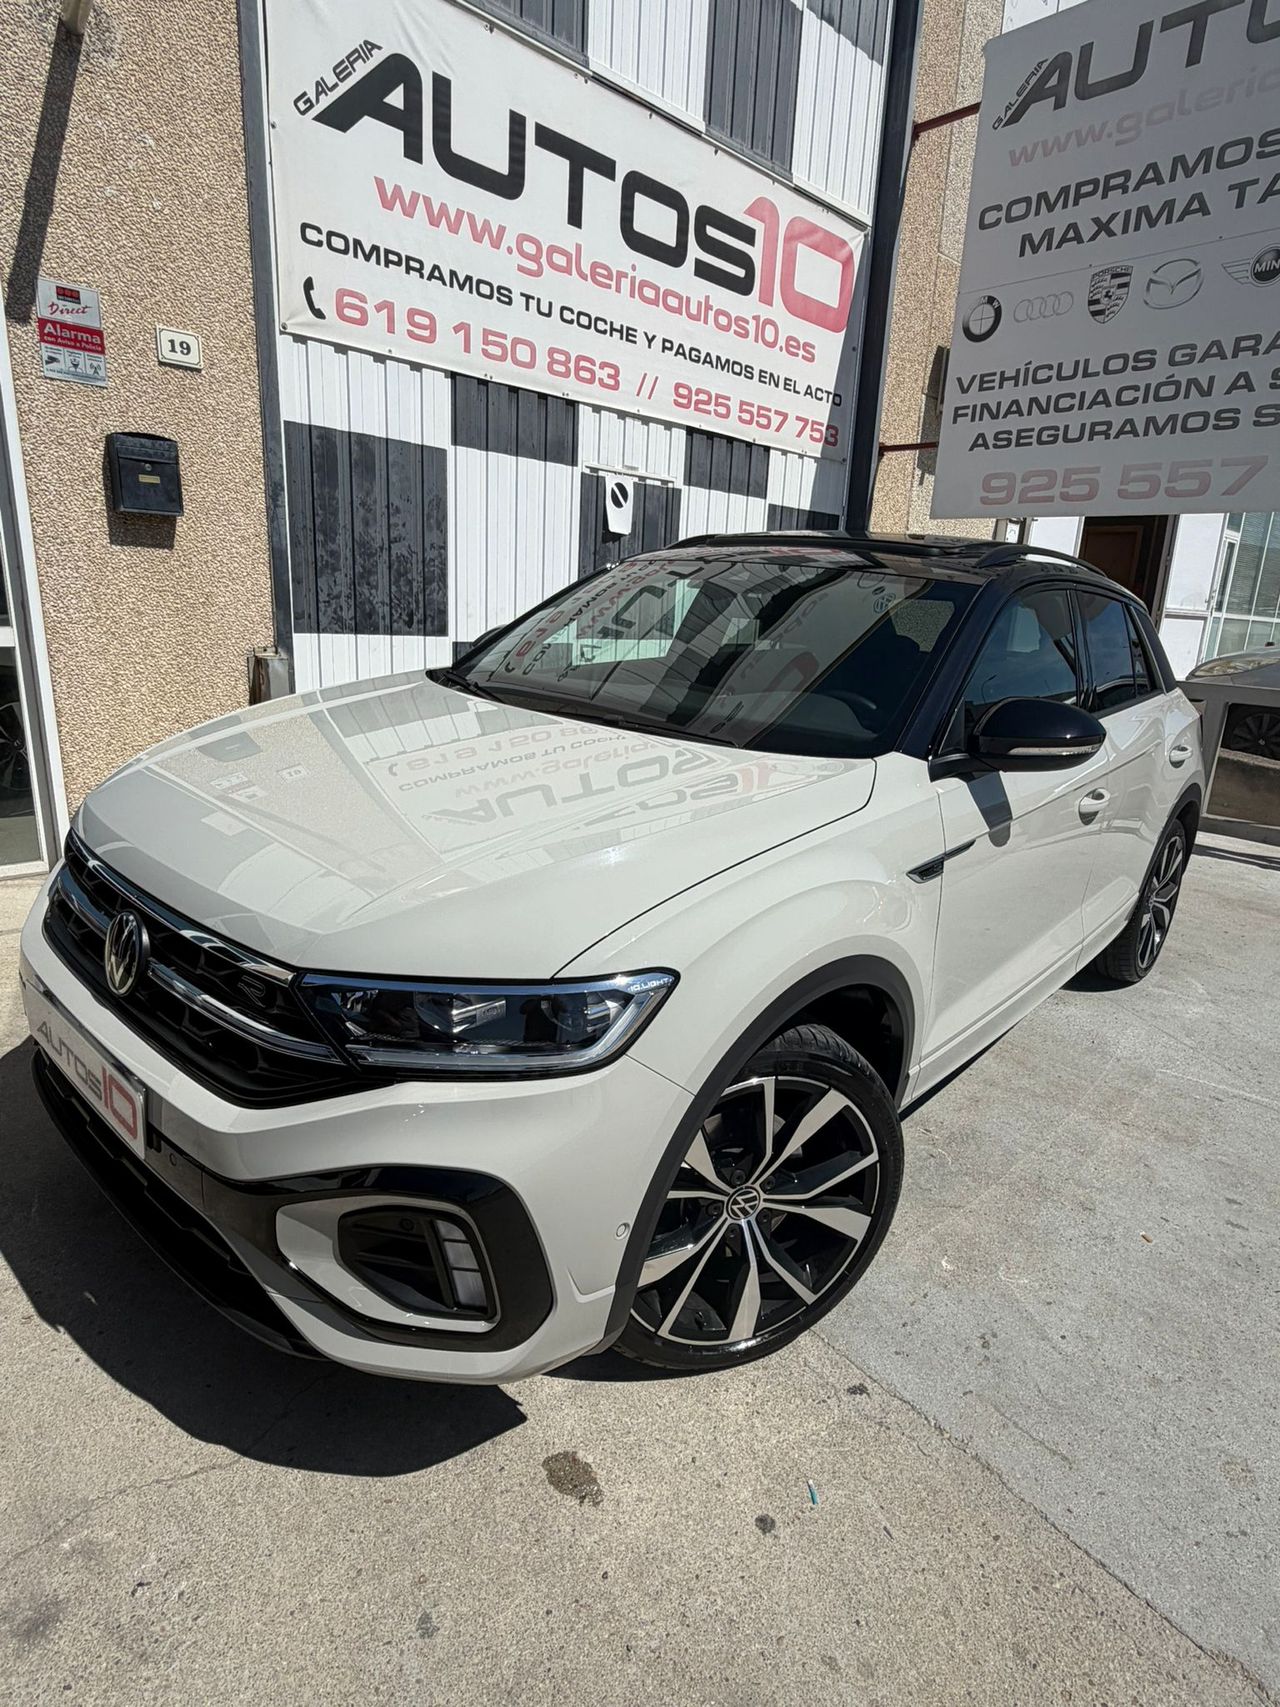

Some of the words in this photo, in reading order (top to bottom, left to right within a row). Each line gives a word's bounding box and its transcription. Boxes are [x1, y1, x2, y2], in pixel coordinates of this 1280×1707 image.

[293, 39, 383, 116] GALERIA
[992, 58, 1048, 130] GALERIA
[978, 128, 1280, 231] COMPRAMOS
[1019, 191, 1212, 258] MAXIMA
[373, 175, 817, 364] www.galeriaautos10.es
[43, 322, 101, 344] Alarma
[48, 301, 93, 315] Direct
[300, 222, 513, 307] COMPRAMOS
[520, 292, 553, 318] TU
[559, 305, 638, 344] COCHE
[643, 331, 657, 349] Y
[661, 337, 755, 381] PAGAMOS
[758, 369, 781, 389] EN
[783, 374, 802, 395] EL
[803, 387, 843, 407] ACTO
[167, 339, 191, 356] 19
[335, 287, 438, 344] 619
[452, 321, 537, 369] 150
[547, 346, 621, 391] 863
[673, 381, 732, 420] 925
[738, 400, 789, 433] 557
[795, 416, 839, 447] 753
[956, 348, 1158, 395] VEHÍCULOS
[952, 374, 1216, 425] FINANCIACIÓN
[1224, 371, 1256, 395] A
[968, 408, 1241, 452] ASEGURAMOS
[980, 465, 1101, 506] 925
[1117, 455, 1269, 501] 557
